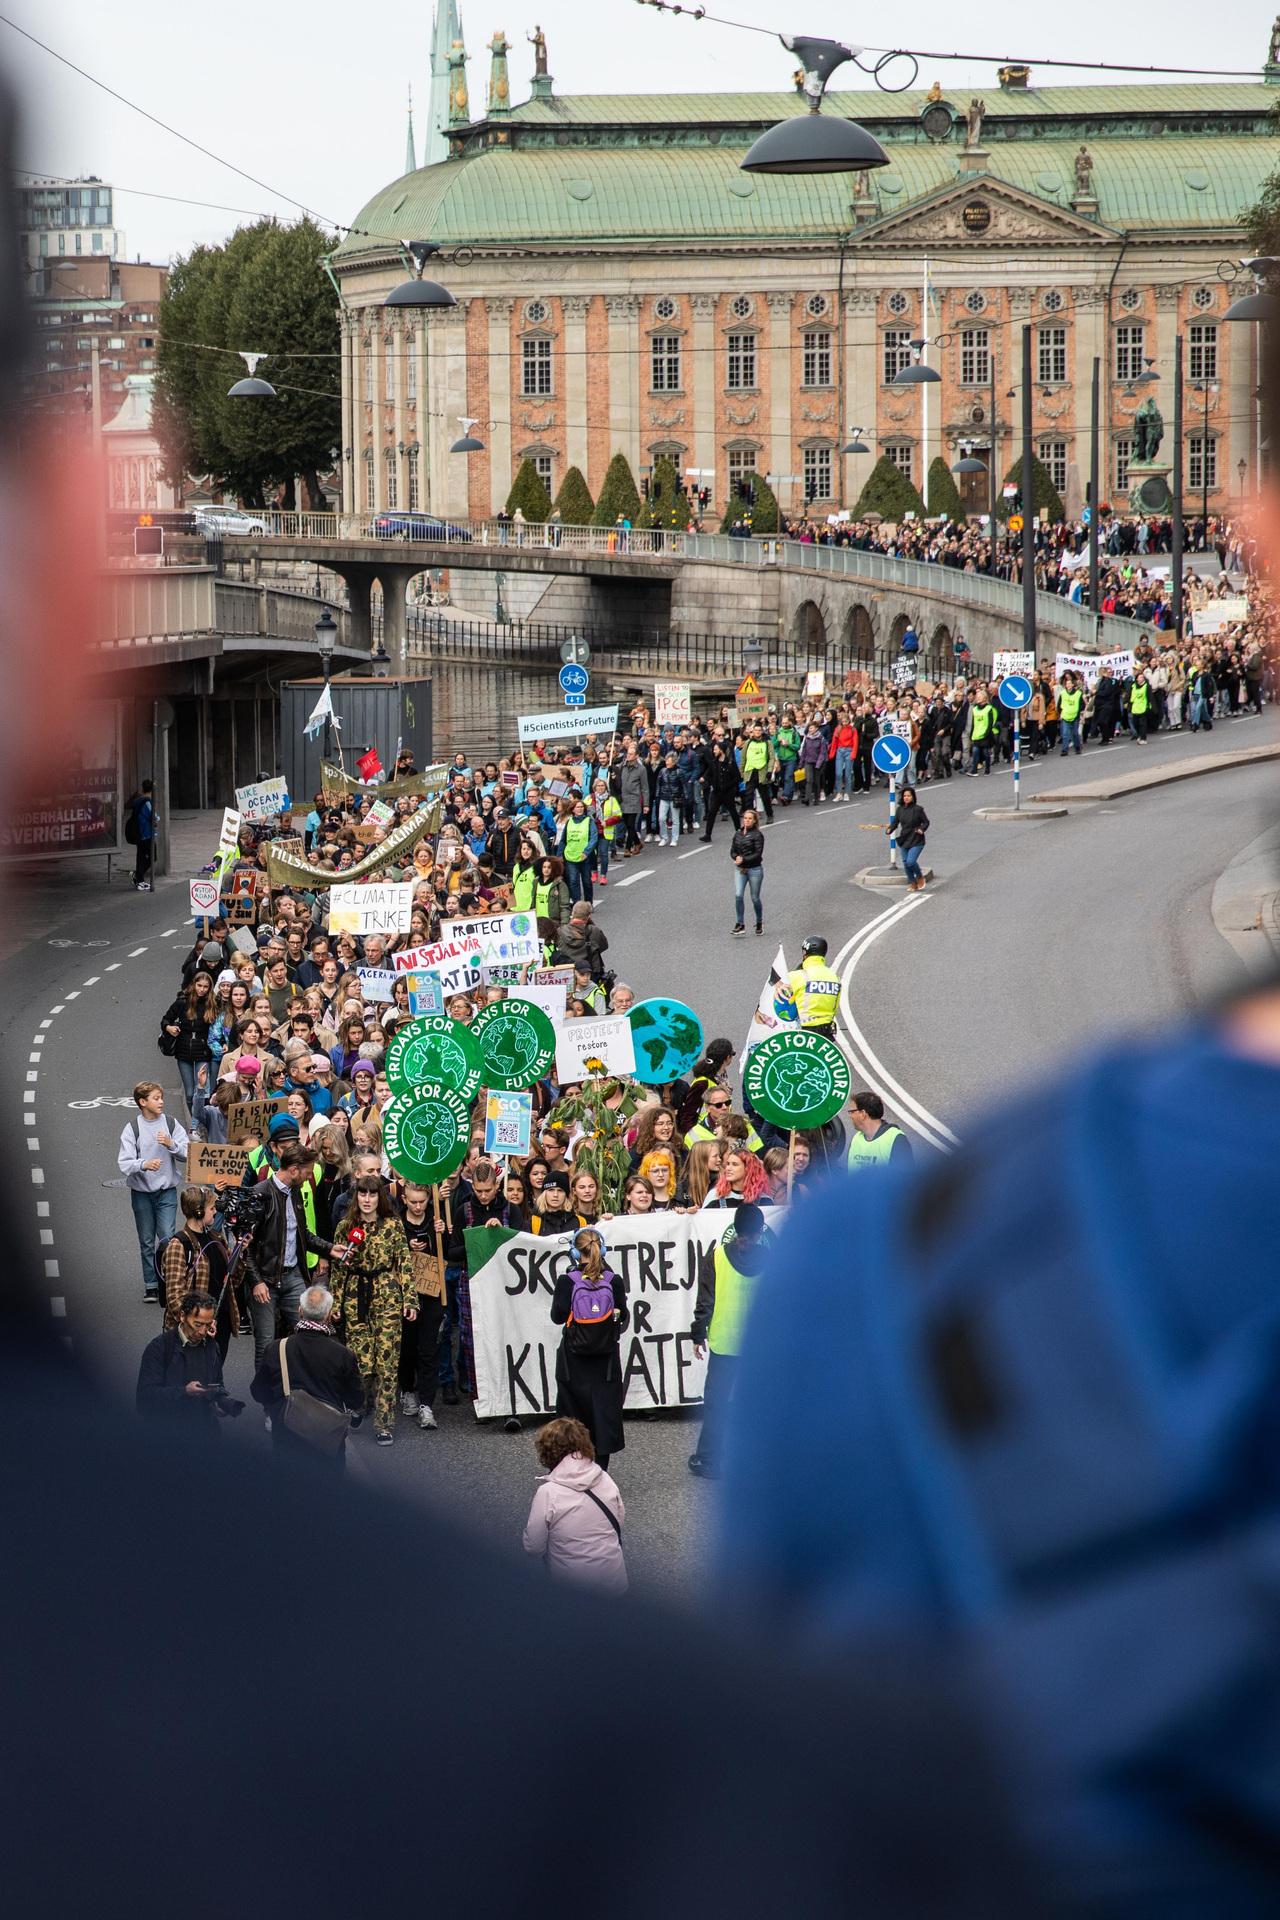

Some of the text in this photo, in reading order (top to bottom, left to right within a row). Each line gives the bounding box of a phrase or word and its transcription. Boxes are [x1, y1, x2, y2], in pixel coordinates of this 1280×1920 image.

[1100, 655, 1129, 667] LATIN
[657, 698, 689, 710] IPCC
[523, 715, 615, 733] #ScientistsForFuture
[237, 786, 258, 800] LIKE
[248, 792, 279, 808] OCEAN
[242, 809, 257, 819] WE
[333, 889, 409, 905] #CLIMATE
[452, 918, 504, 938] PROTECT
[458, 935, 482, 953] VÅR
[358, 969, 387, 980] AGERA
[415, 975, 433, 985] GO
[539, 972, 554, 980] WE
[808, 980, 840, 994] POLIS
[502, 1001, 530, 1017] FOR
[567, 1020, 624, 1042] PROTECT
[389, 1023, 422, 1082] FRIDAYS
[424, 1017, 454, 1034] FOR
[577, 1040, 609, 1051] restore
[505, 1048, 552, 1090] FUTURE
[748, 1033, 848, 1101] FRIDAYS FOR FUTURE
[250, 1105, 260, 1116] IS
[262, 1102, 279, 1114] NO
[497, 1098, 521, 1112] GO
[384, 1084, 470, 1160] FRIDAYS FOR FUTURE
[200, 1146, 249, 1160] ACT LIK
[198, 1158, 219, 1168] THE
